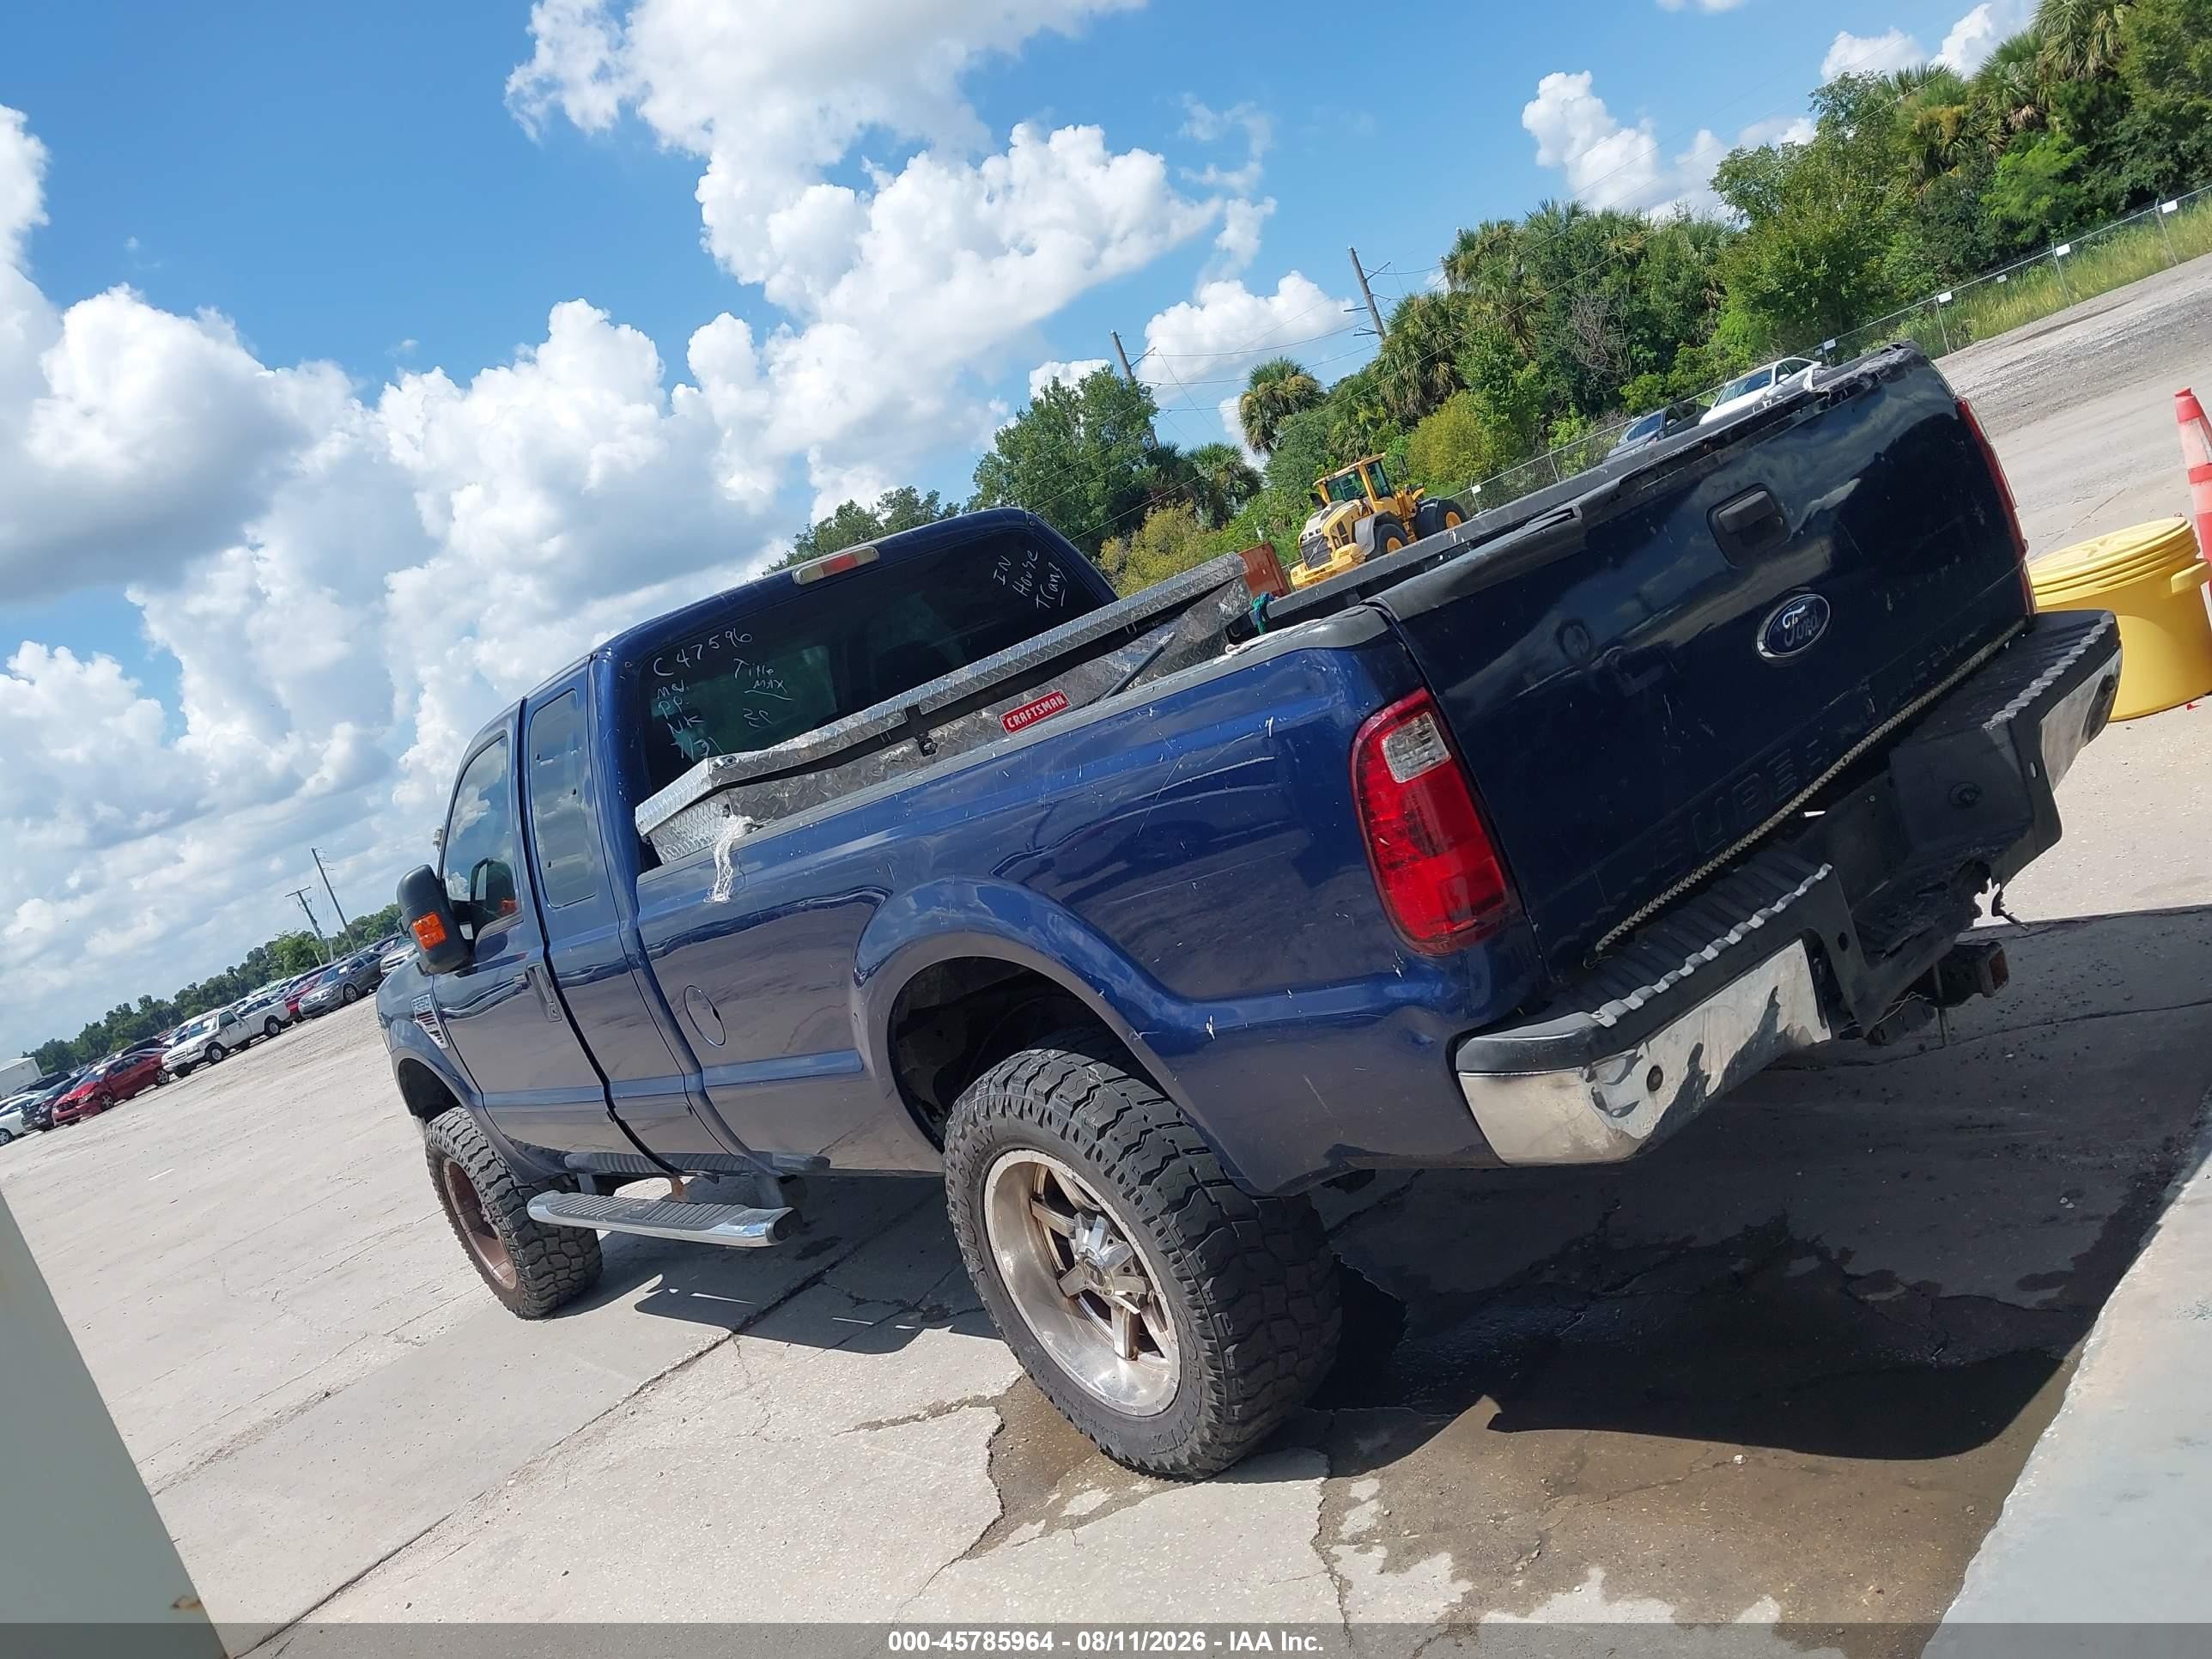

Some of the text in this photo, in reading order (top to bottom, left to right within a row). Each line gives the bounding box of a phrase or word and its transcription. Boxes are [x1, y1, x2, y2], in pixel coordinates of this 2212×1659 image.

[994, 555, 1011, 586] IN
[1782, 604, 1819, 647] Ford
[733, 658, 774, 679] Title
[1006, 695, 1066, 729] CRAFTSMAN
